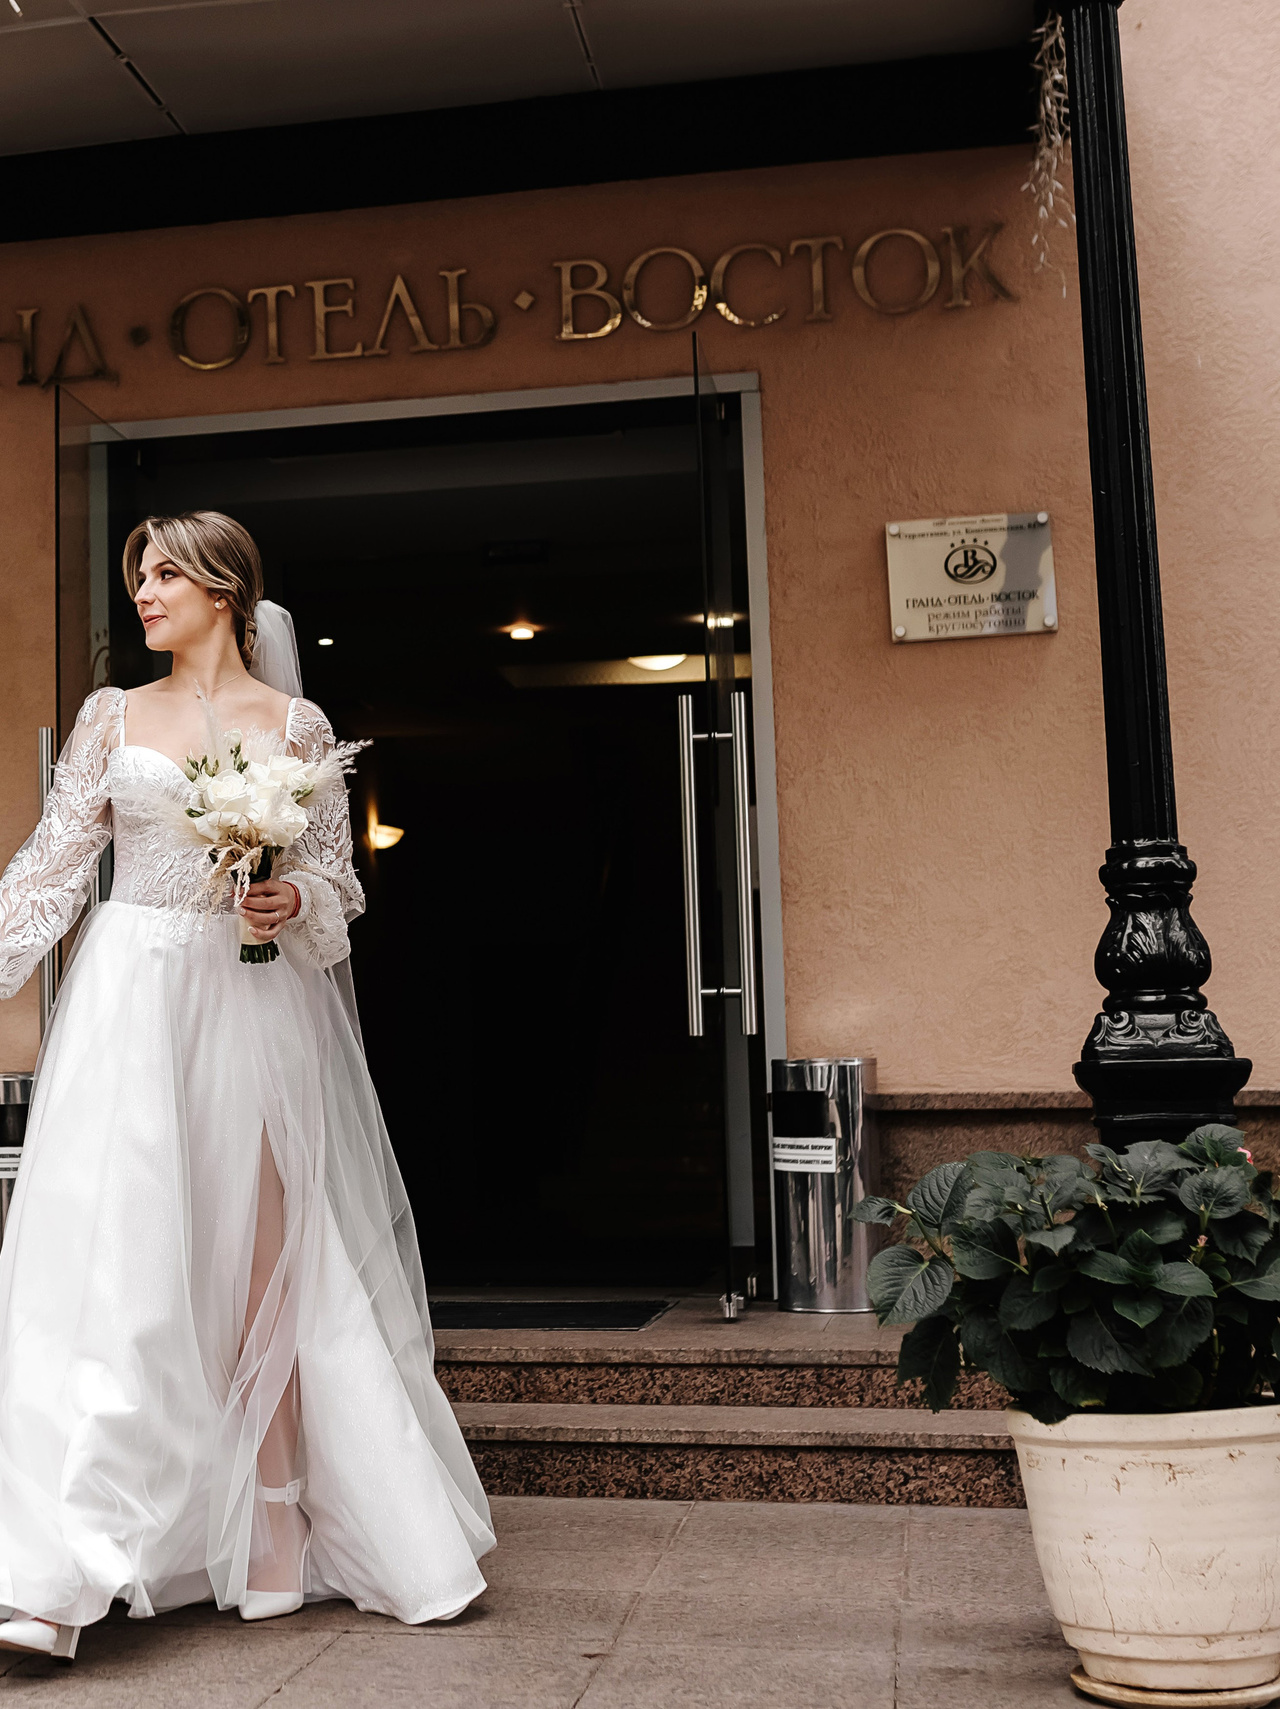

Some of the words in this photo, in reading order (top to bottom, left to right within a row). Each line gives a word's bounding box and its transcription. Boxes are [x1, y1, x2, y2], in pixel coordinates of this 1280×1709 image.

[170, 271, 496, 371] ОТЕЛЬ
[553, 222, 1013, 341] ВОСТОК
[927, 611, 970, 623] режим
[928, 617, 1026, 635] круглосуточно
